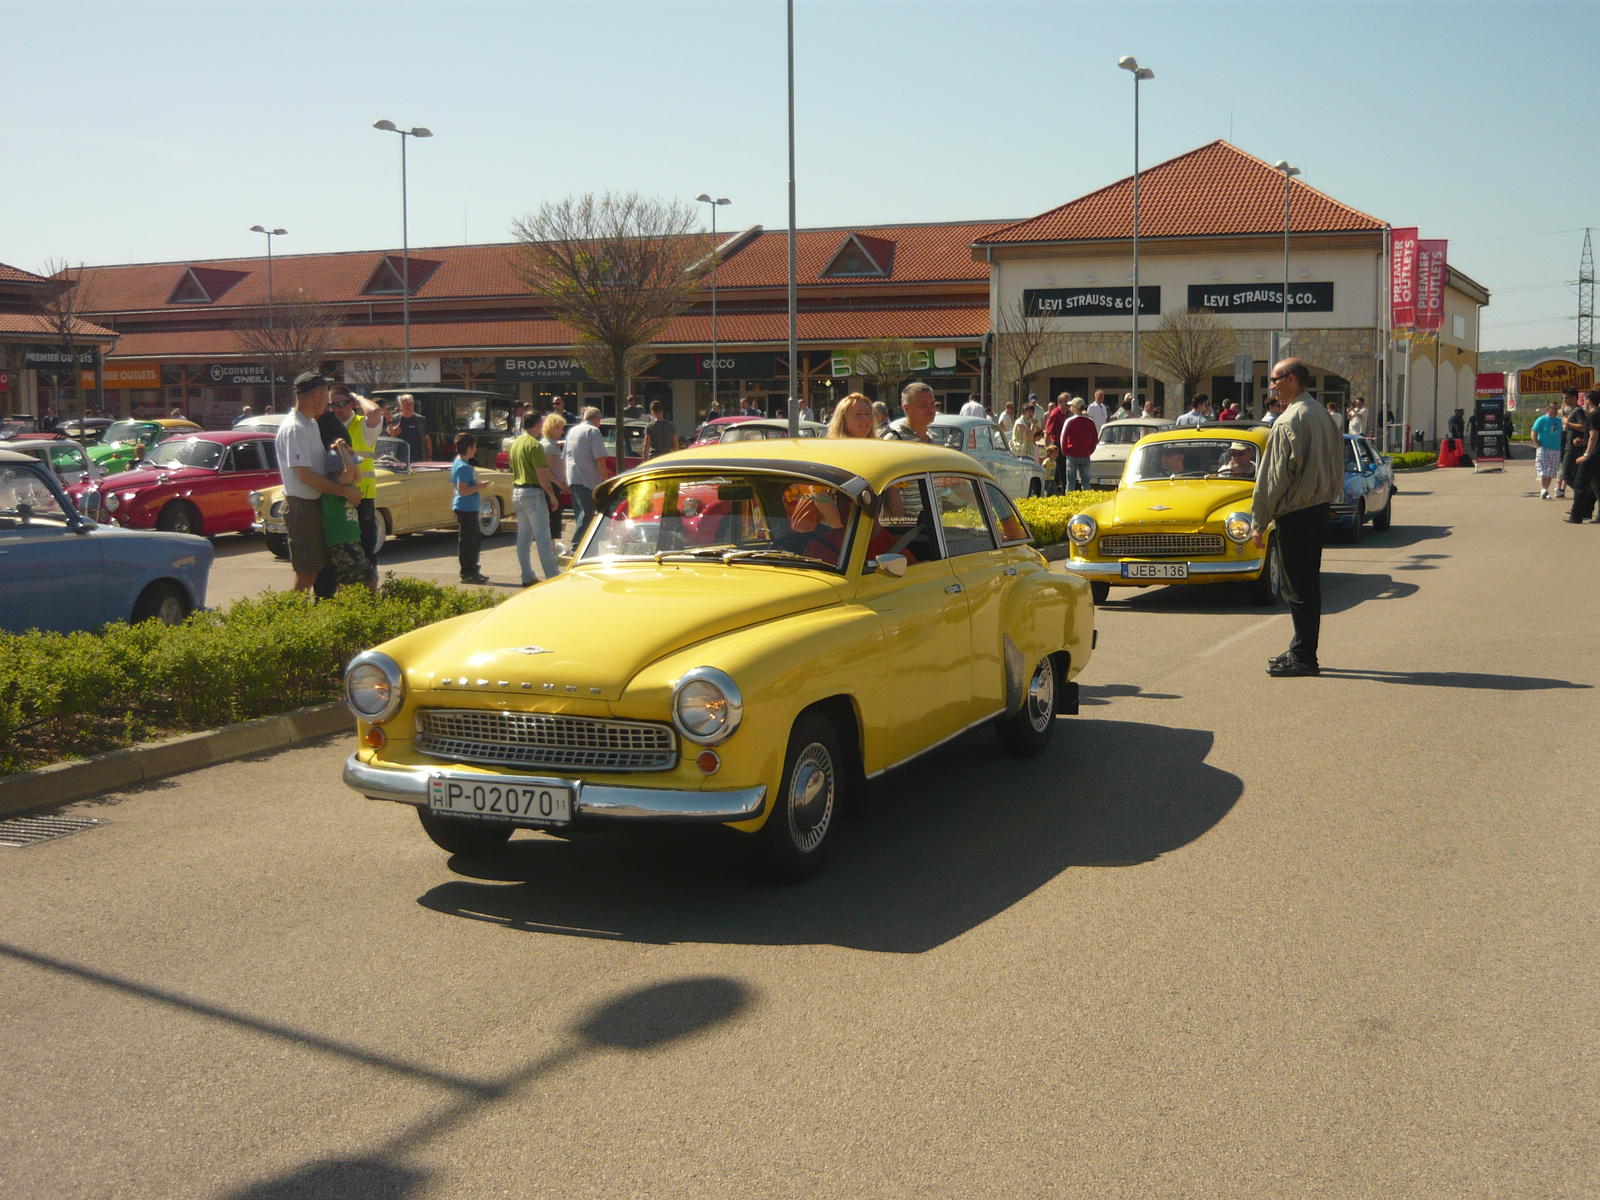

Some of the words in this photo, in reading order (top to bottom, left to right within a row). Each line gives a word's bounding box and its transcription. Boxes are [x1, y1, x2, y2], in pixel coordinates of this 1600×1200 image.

[1393, 240, 1404, 303] PREMIER
[1401, 239, 1414, 302] OUTLETS
[1417, 251, 1429, 309] PREMIER
[1429, 251, 1442, 309] OUTLETS
[1038, 299, 1062, 310] LEVI
[1065, 294, 1112, 308] STRAUSS
[1114, 299, 1123, 309] &
[1203, 294, 1229, 307] LEVI
[1232, 290, 1282, 305] STRAUSS
[1295, 293, 1317, 305] CO.
[26, 353, 60, 362] PREMIER
[120, 369, 157, 380] OUTLETS
[223, 366, 266, 375] CONVERSE
[1131, 565, 1185, 577] JEB-136
[433, 794, 444, 807] H
[448, 783, 553, 817] P-02070
